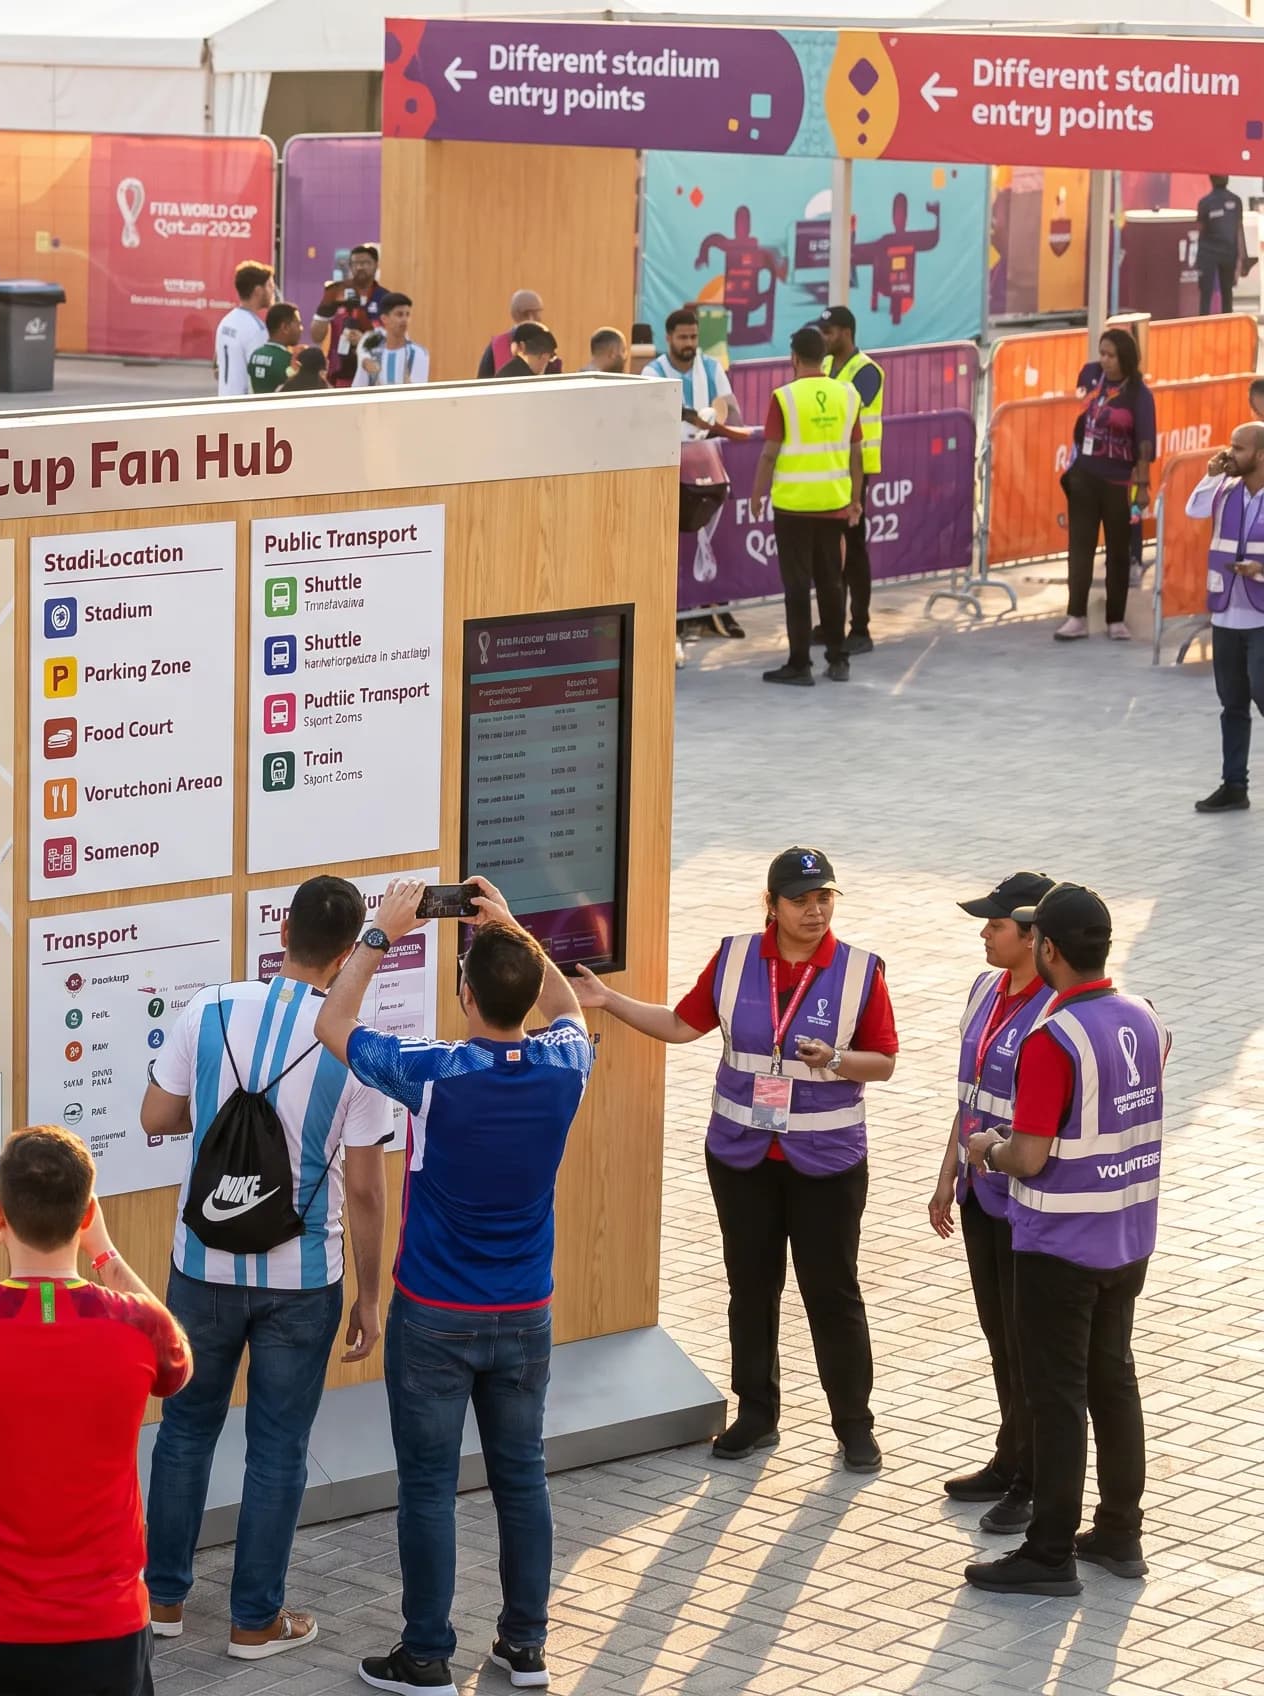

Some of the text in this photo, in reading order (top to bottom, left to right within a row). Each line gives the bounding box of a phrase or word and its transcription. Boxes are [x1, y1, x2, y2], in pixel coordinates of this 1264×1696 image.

[489, 44, 720, 79] Different stadium
[972, 58, 1240, 96] Different stadium
[488, 82, 645, 116] entry points
[971, 100, 1154, 137] entry points
[149, 201, 258, 219] FIFA WORLD CUP
[91, 440, 179, 489] Fan
[196, 426, 293, 480] Hub
[871, 479, 913, 507] CUP
[265, 524, 418, 553] Public Transport
[304, 573, 362, 594] Shuttle
[85, 603, 152, 622] Stadium
[304, 631, 362, 651] Shuttle
[53, 665, 69, 691] P
[85, 659, 191, 683] Parking Zone
[360, 682, 430, 705] Transport
[85, 719, 174, 742] Food Court
[303, 748, 343, 767] Train
[43, 924, 138, 951] Transport
[215, 1174, 261, 1204] NIKE
